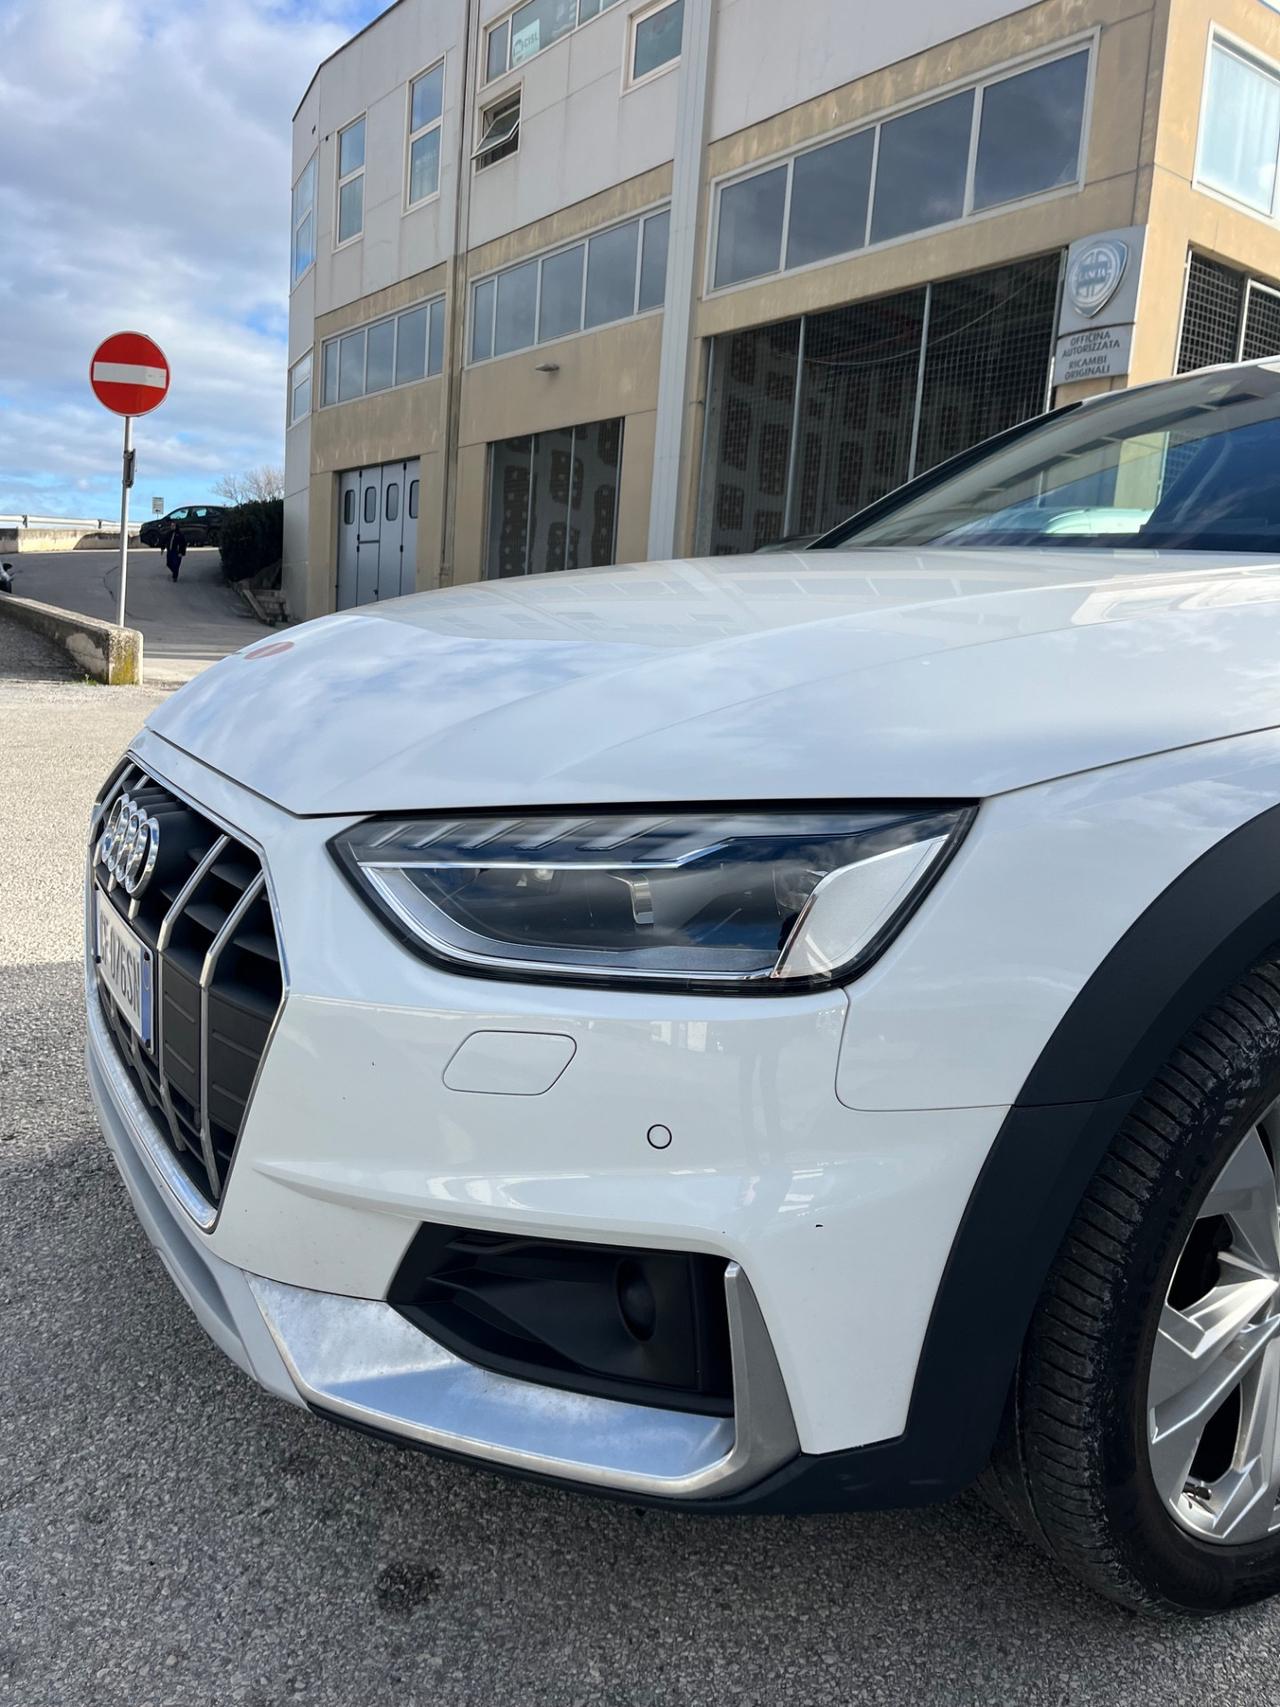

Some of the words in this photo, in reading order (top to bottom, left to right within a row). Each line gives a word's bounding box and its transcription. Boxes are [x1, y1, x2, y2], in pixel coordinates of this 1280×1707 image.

[1070, 331, 1111, 347] OFFICINA
[1062, 339, 1121, 358] AUTORIZZATA
[1069, 355, 1107, 370] RICAMBI
[1065, 364, 1111, 380] ORIGINALI
